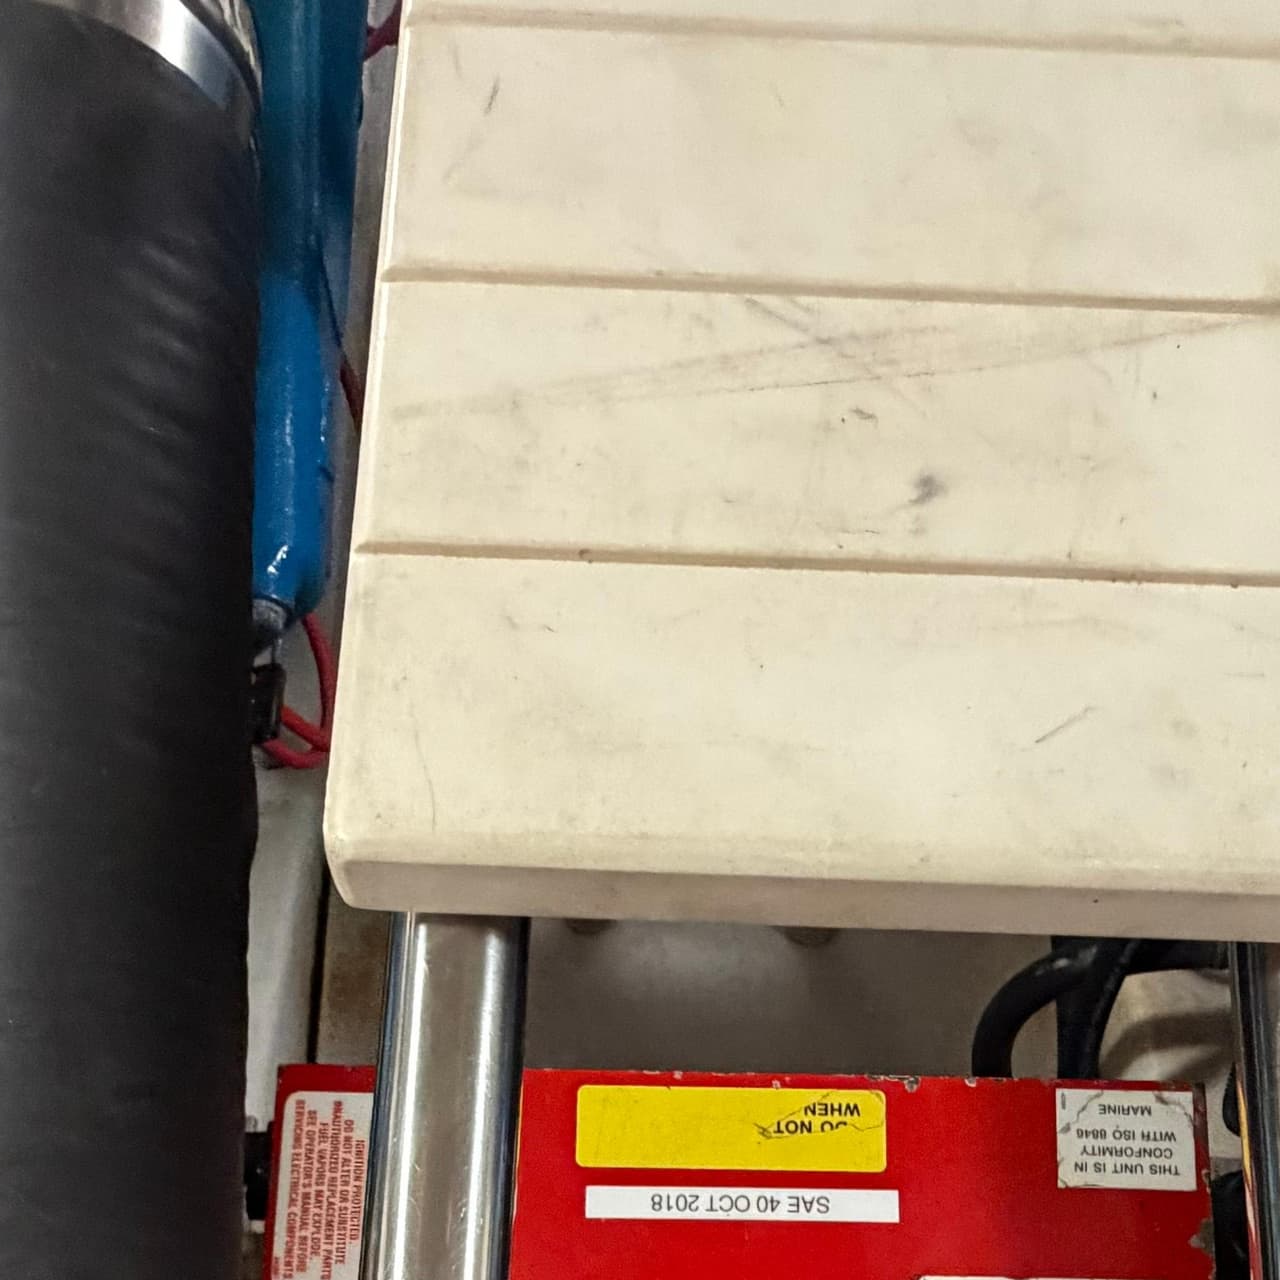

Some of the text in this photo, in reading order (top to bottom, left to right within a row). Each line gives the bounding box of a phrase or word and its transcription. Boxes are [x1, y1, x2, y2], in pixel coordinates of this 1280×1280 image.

[804, 1103, 860, 1116] WHEN
[1098, 1104, 1152, 1116] MARINE
[319, 1123, 329, 1145] FUEL
[329, 1101, 342, 1173] UNAUTHORIZED
[773, 1120, 812, 1134] NOT
[1113, 1130, 1135, 1141] ISO
[1141, 1130, 1176, 1142] WITH
[354, 1140, 365, 1181] IGNITION
[1080, 1146, 1172, 1159] CONFORMITY
[316, 1149, 327, 1186] VAPORS
[1074, 1162, 1180, 1176] THIS UNIT IS IN
[288, 1152, 302, 1209] ELECTRICAL
[296, 1110, 317, 1272] SEE OPERATOR'S MANUAL BEFORE
[314, 1190, 324, 1211] MAY
[335, 1120, 354, 1264] DO NOT ALTER OR SUBSTITUTE
[323, 1177, 337, 1245] REPLACEMENT
[651, 1194, 830, 1214] SAE 40 OCT 2018
